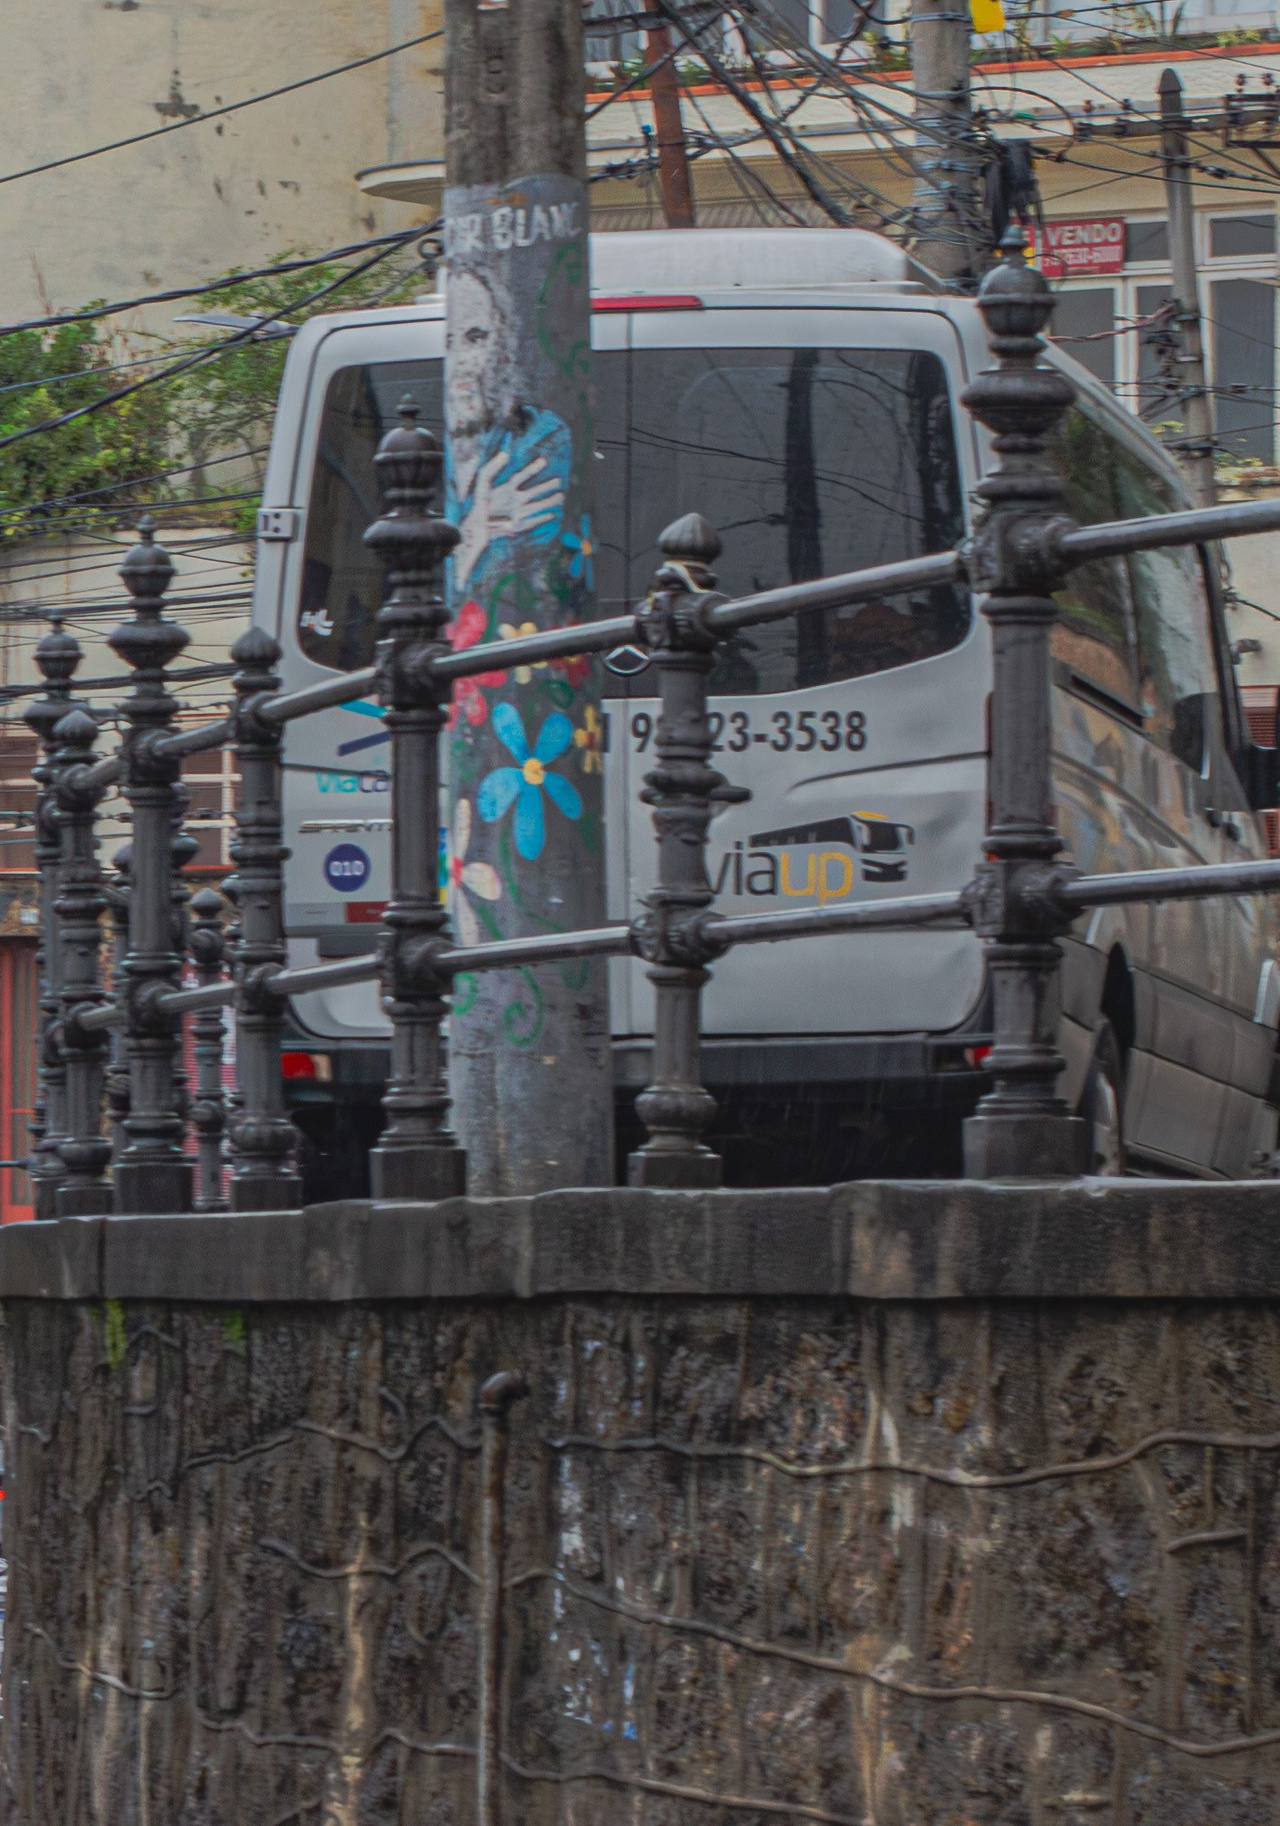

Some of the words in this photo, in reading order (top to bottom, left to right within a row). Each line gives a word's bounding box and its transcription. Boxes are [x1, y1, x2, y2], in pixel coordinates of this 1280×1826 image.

[1045, 223, 1120, 246] VENDO
[632, 711, 867, 752] 923-3538
[329, 860, 365, 877] 010
